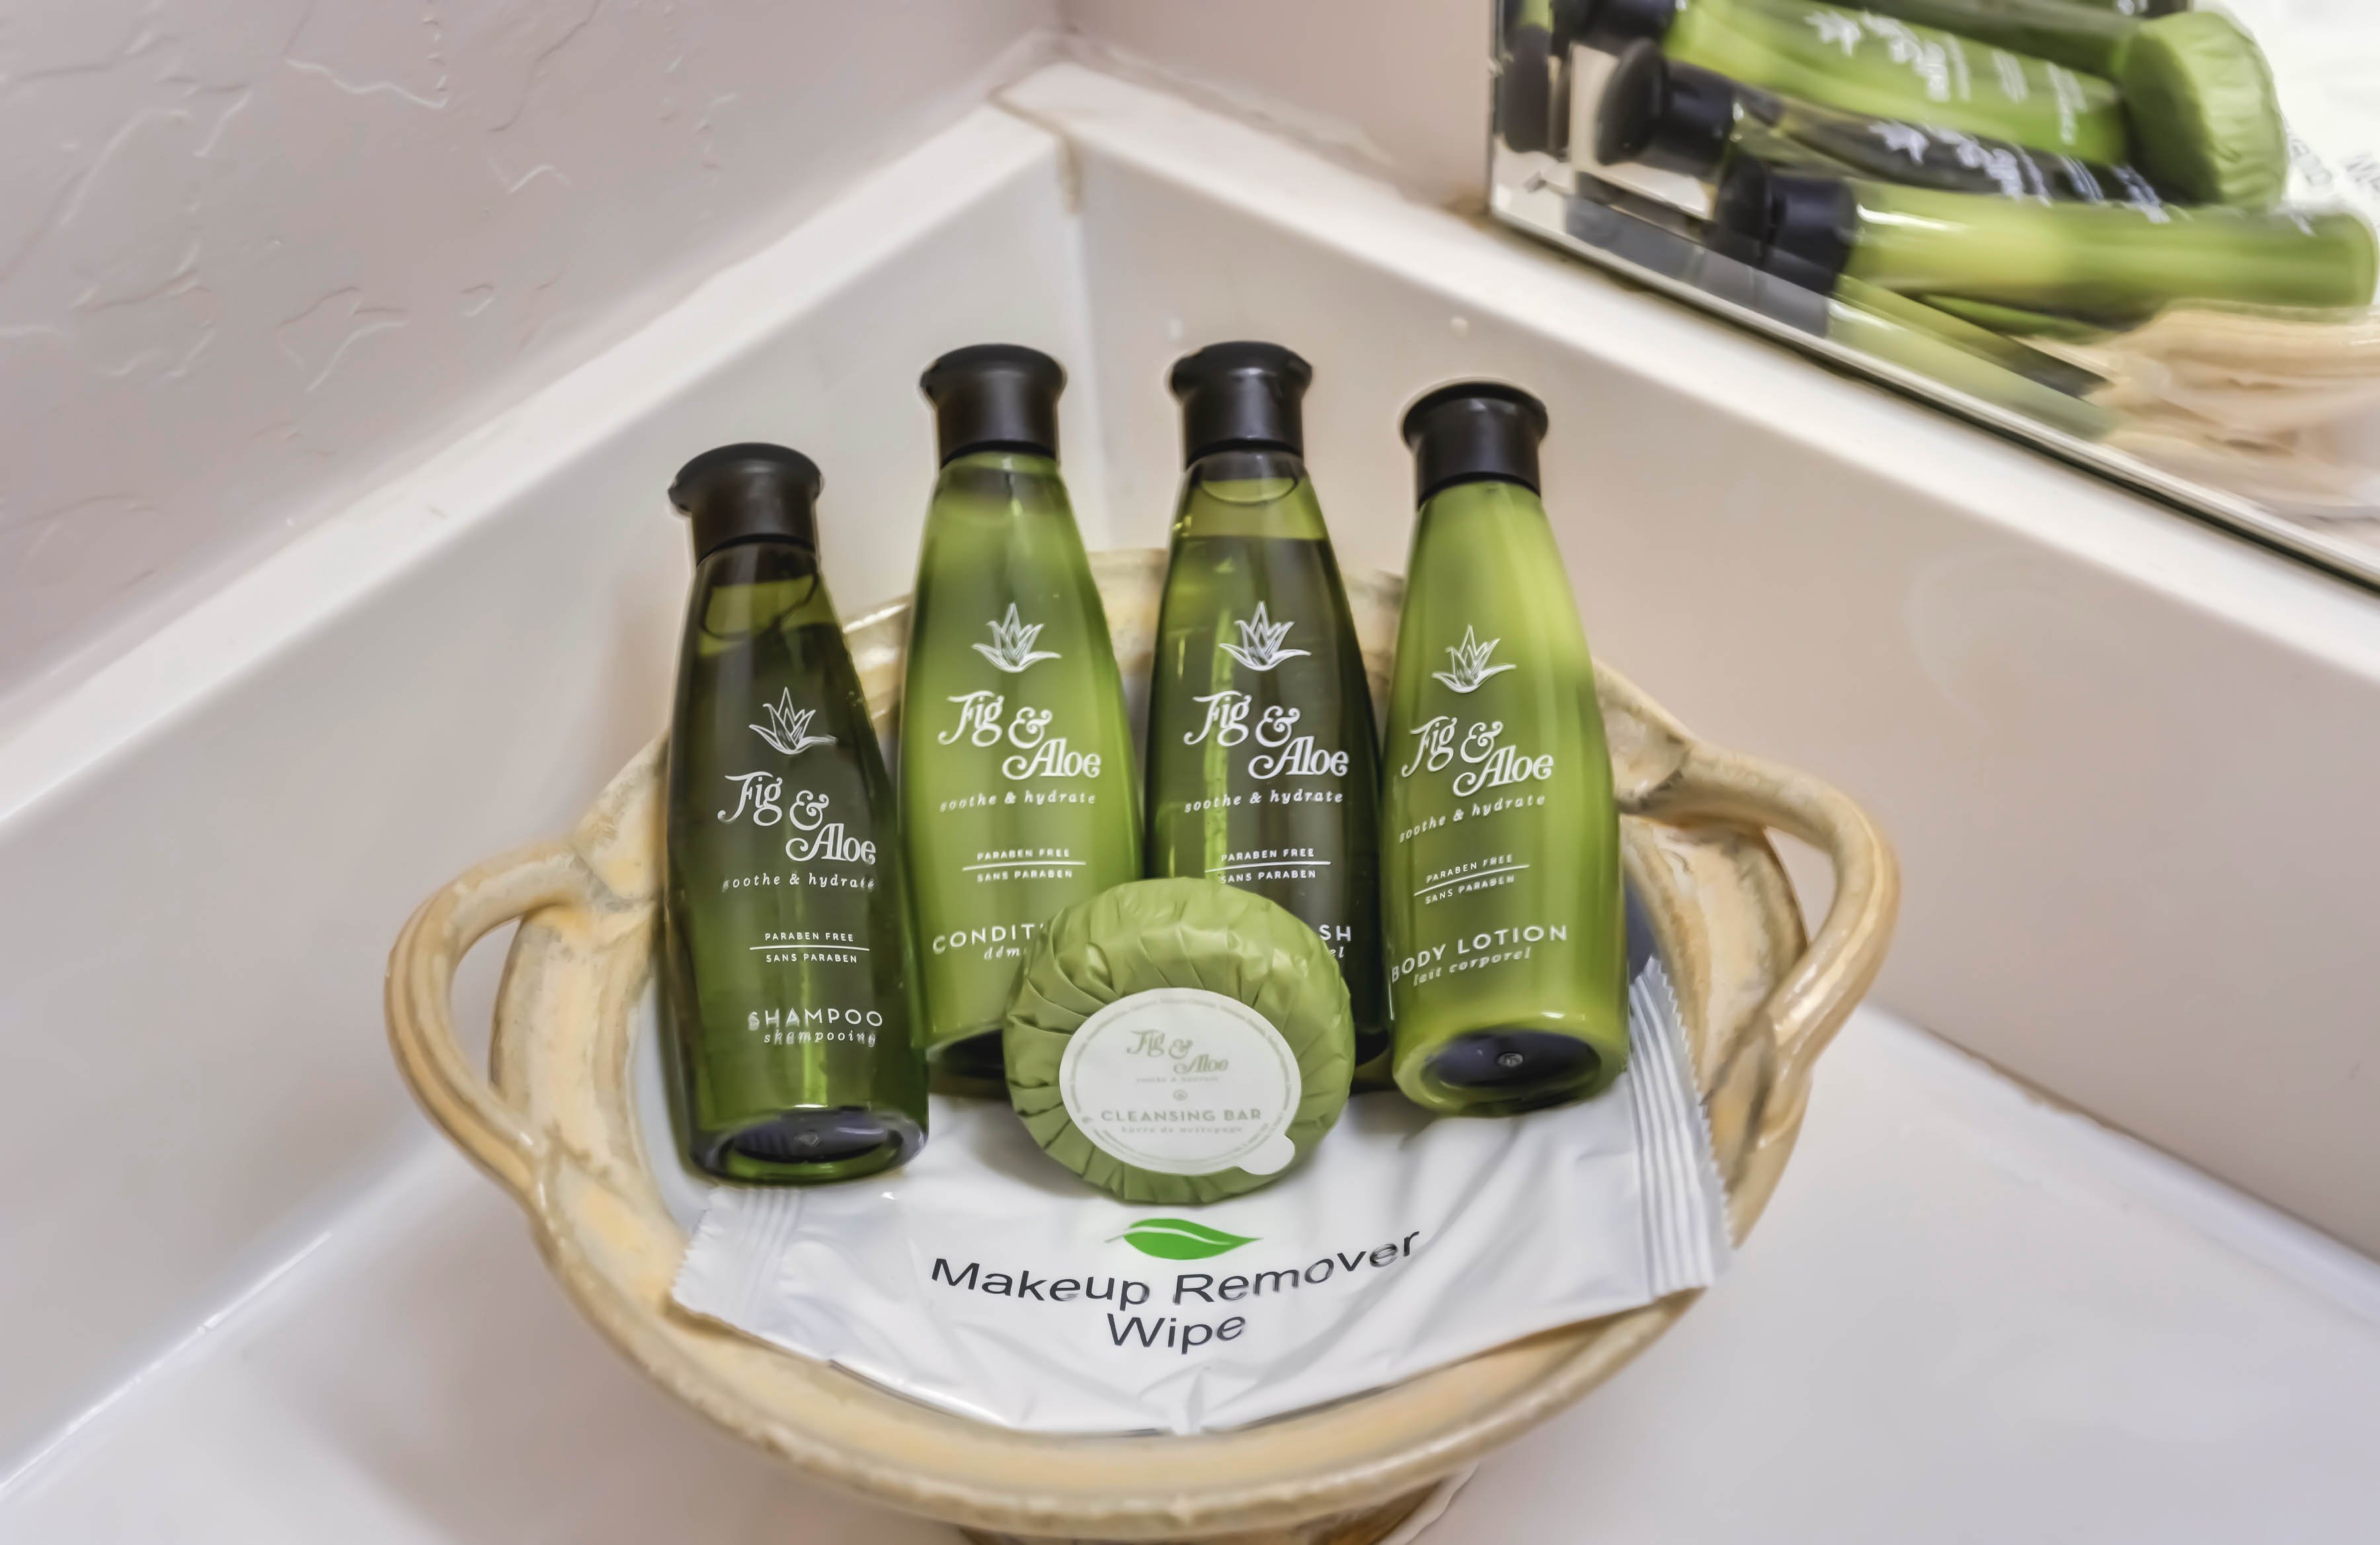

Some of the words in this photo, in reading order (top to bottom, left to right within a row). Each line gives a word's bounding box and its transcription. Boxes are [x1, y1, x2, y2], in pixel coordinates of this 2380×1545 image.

[937, 690, 1004, 747] Fig
[1008, 707, 1052, 749] &
[1183, 690, 1253, 746] Fig
[1255, 705, 1300, 747] &
[1002, 738, 1101, 781] Aloe
[1248, 735, 1349, 779] Aloe
[1401, 715, 1458, 777] Fig
[1460, 721, 1503, 764] &
[1453, 745, 1554, 797] Aloe
[717, 771, 783, 826] Fig
[789, 790, 829, 830] &
[940, 791, 997, 812] soothe
[1004, 791, 1016, 805] &
[1025, 790, 1096, 806] hydrate
[1185, 793, 1242, 813] soothe
[1250, 792, 1262, 804] &
[1271, 789, 1343, 805] hydrate
[1400, 816, 1446, 843] soothe
[1453, 809, 1464, 821] &
[1472, 795, 1545, 817] hydrate
[785, 823, 877, 865] Aloe
[977, 850, 1033, 861] PARABEN
[1039, 848, 1070, 857] FREE
[1221, 850, 1277, 861] PARABEN
[1283, 848, 1314, 857] FREE
[722, 873, 780, 892] soothe
[789, 871, 800, 885] &
[808, 872, 876, 892] hydrate
[977, 871, 1008, 883] SANS
[1015, 870, 1072, 879] PARABEN
[1221, 872, 1251, 884] SANS
[1259, 870, 1316, 880] PARABEN
[1427, 861, 1477, 884] PARABEN
[1482, 854, 1513, 867] FREE
[1425, 889, 1453, 904] SANS
[1458, 875, 1514, 894] PARABEN
[765, 931, 820, 941] PARABEN
[825, 932, 854, 942] FREE
[933, 923, 1044, 954] CONDIT
[1319, 924, 1351, 941] SH
[766, 953, 797, 963] SANS
[803, 953, 857, 964] PARABEN
[1392, 944, 1446, 984] BODY
[1457, 925, 1567, 955] LOTION
[1448, 946, 1532, 973] corporel
[748, 1008, 883, 1031] SHAMPOO
[764, 1029, 877, 1047] shampooing
[1101, 1110, 1216, 1122] CLEANSING
[1224, 1109, 1261, 1121] BAR
[931, 1257, 1150, 1312] Makeup
[1173, 1230, 1420, 1305] Remover
[1107, 1312, 1246, 1355] Wipe
